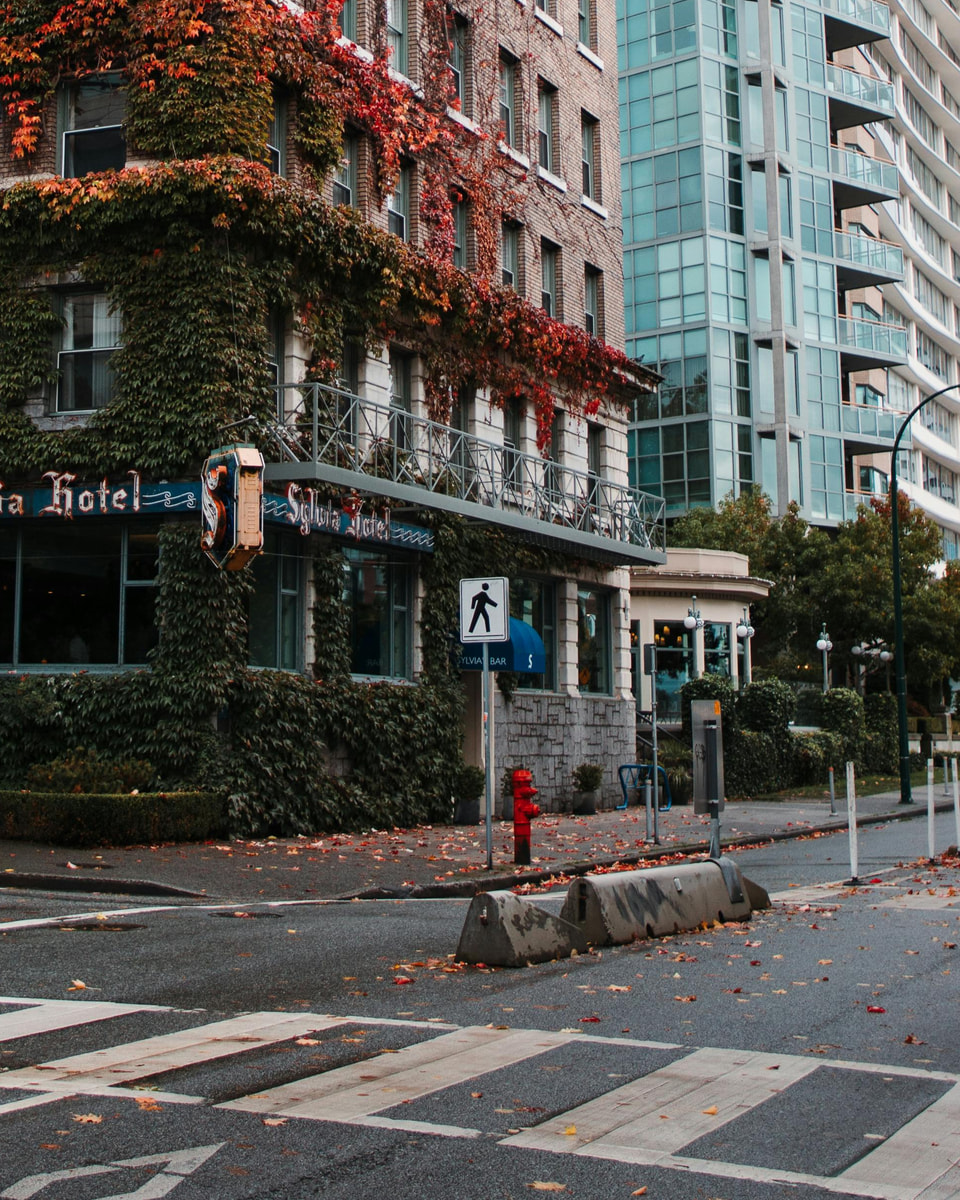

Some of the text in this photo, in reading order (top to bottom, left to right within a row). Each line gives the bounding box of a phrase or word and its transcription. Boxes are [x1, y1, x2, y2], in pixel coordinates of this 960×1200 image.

[39, 470, 140, 520] Hotel
[285, 482, 340, 536] Sylvia
[490, 657, 507, 665] BAR
